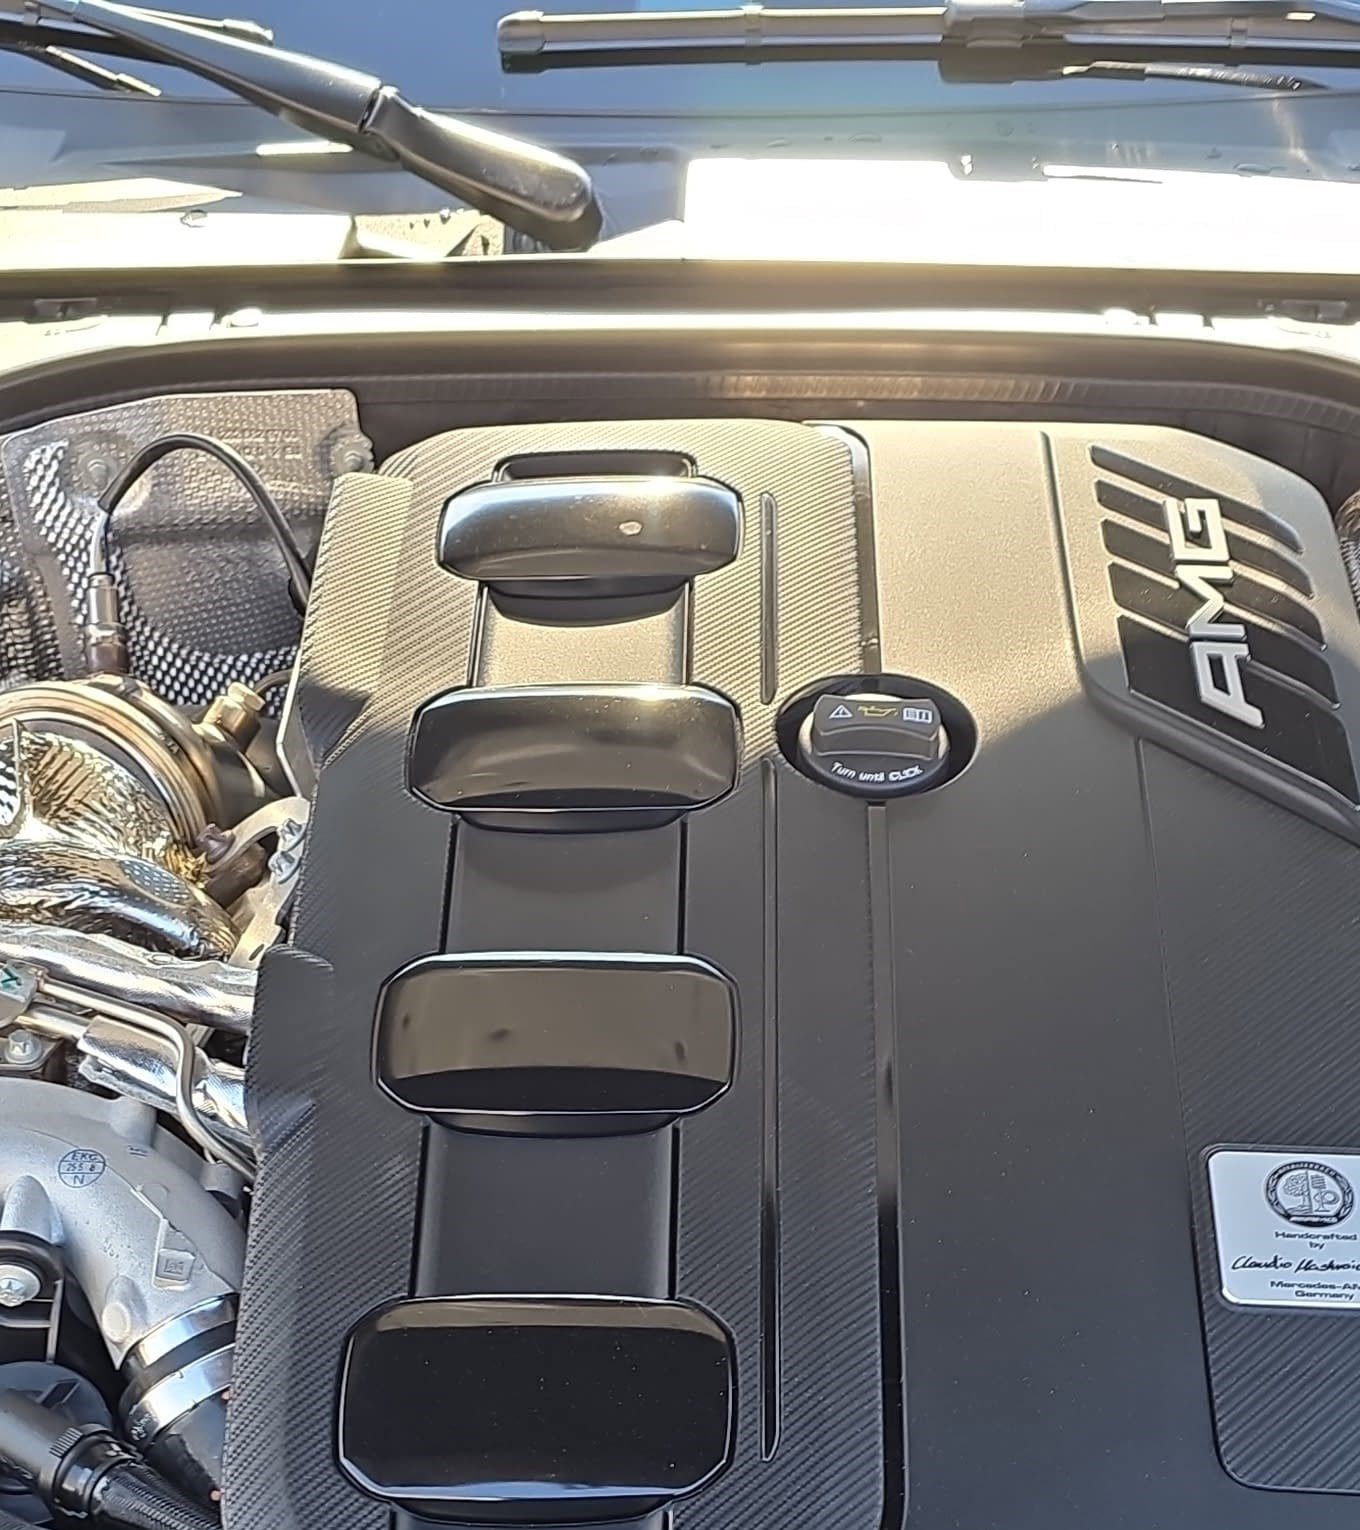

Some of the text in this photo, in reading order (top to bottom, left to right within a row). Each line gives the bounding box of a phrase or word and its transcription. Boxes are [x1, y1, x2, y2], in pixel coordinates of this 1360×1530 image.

[1164, 497, 1265, 728] AMG
[831, 761, 856, 779] Turn
[858, 770, 885, 783] until
[72, 1174, 85, 1185] N
[1274, 1230, 1358, 1241] Handcrafted
[1308, 1241, 1325, 1250] by
[1231, 1255, 1292, 1270] Claudio
[1294, 1290, 1355, 1300] Germany
